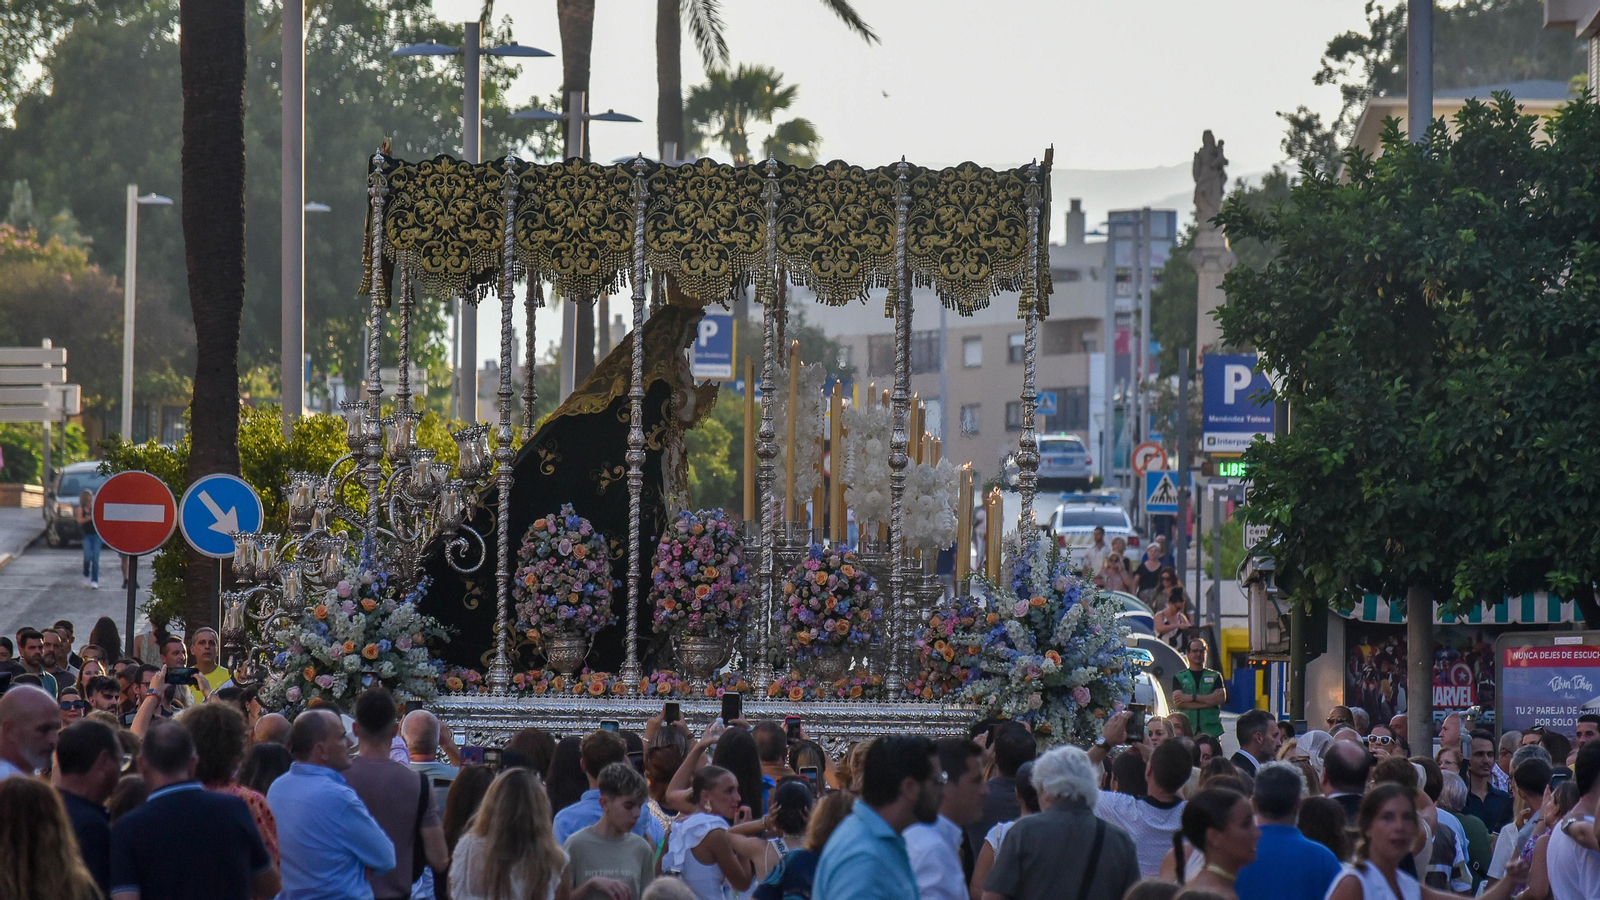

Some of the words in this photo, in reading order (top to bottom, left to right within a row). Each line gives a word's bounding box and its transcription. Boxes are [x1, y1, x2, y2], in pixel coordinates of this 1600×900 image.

[700, 320, 718, 346] P
[1224, 364, 1252, 405] P
[1218, 438, 1252, 447] Interpar
[1513, 651, 1539, 659] NUNCA
[1540, 651, 1561, 659] DEJES
[1561, 651, 1573, 659] DE
[1433, 686, 1474, 706] ARVEL
[1515, 706, 1526, 715] TU
[1536, 706, 1565, 715] PAREJA
[1566, 706, 1578, 715] DE
[1534, 718, 1551, 726] POR
[1552, 718, 1573, 727] SOLO
